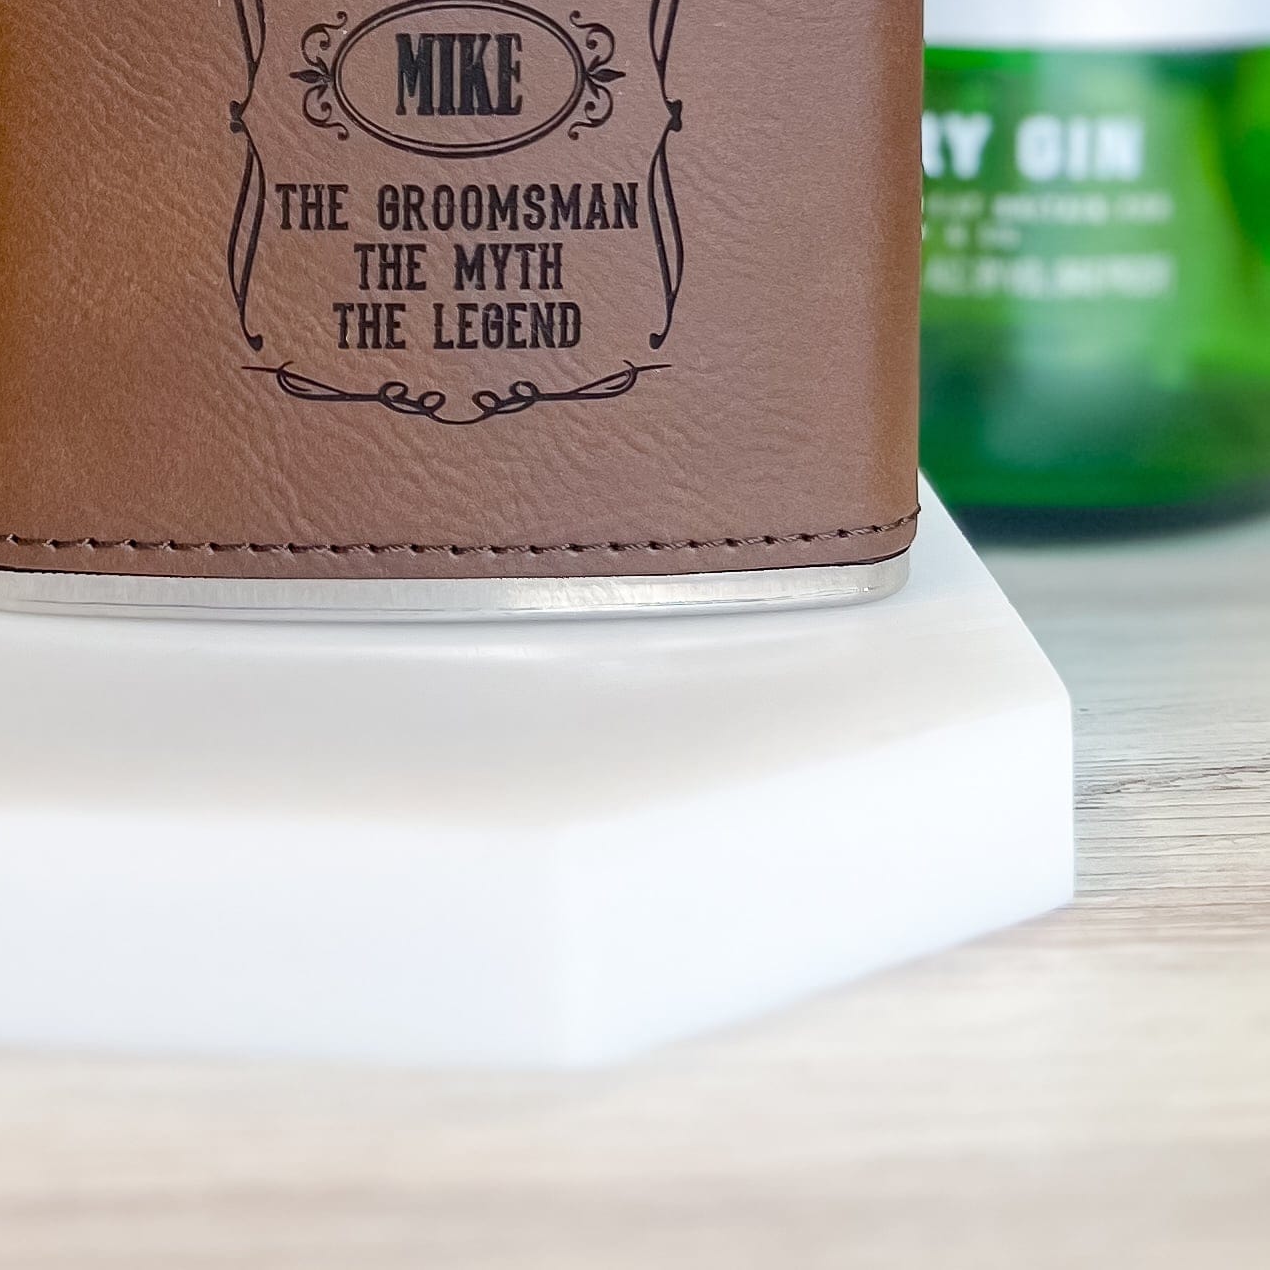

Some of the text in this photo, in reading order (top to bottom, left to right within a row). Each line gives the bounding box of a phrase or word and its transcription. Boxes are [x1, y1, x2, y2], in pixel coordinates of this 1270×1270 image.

[395, 32, 524, 117] MIKE
[1016, 113, 1144, 180] GIN
[275, 182, 639, 232] THE GROOMSMAN
[353, 242, 564, 291] THE MYTH
[332, 301, 583, 350] THE LEGEND
